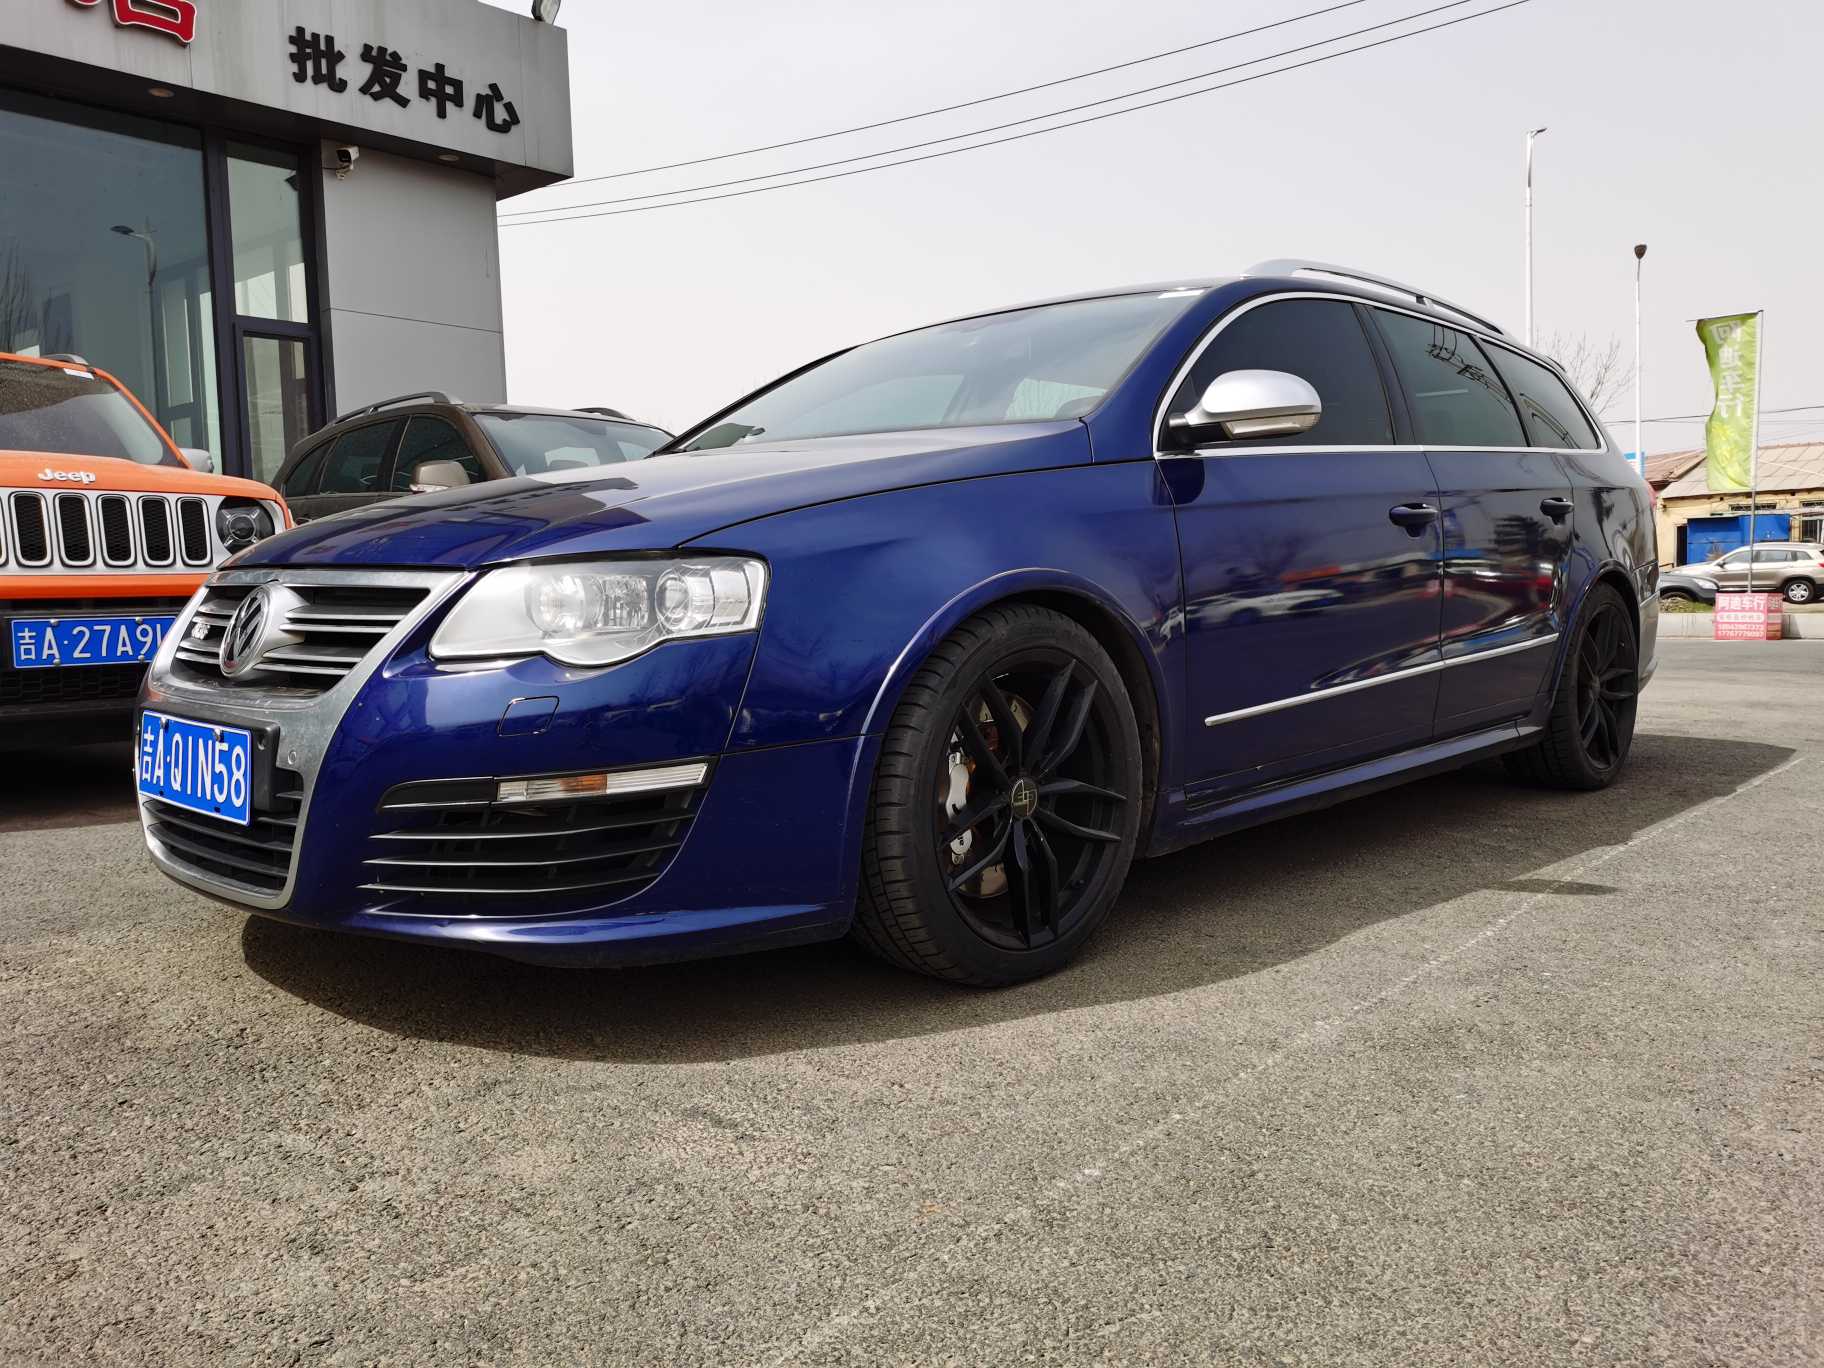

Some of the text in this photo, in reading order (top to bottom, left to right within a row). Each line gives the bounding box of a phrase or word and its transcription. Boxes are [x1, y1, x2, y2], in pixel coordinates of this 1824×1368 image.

[289, 25, 521, 134] 批发中心
[37, 467, 96, 484] Jeep
